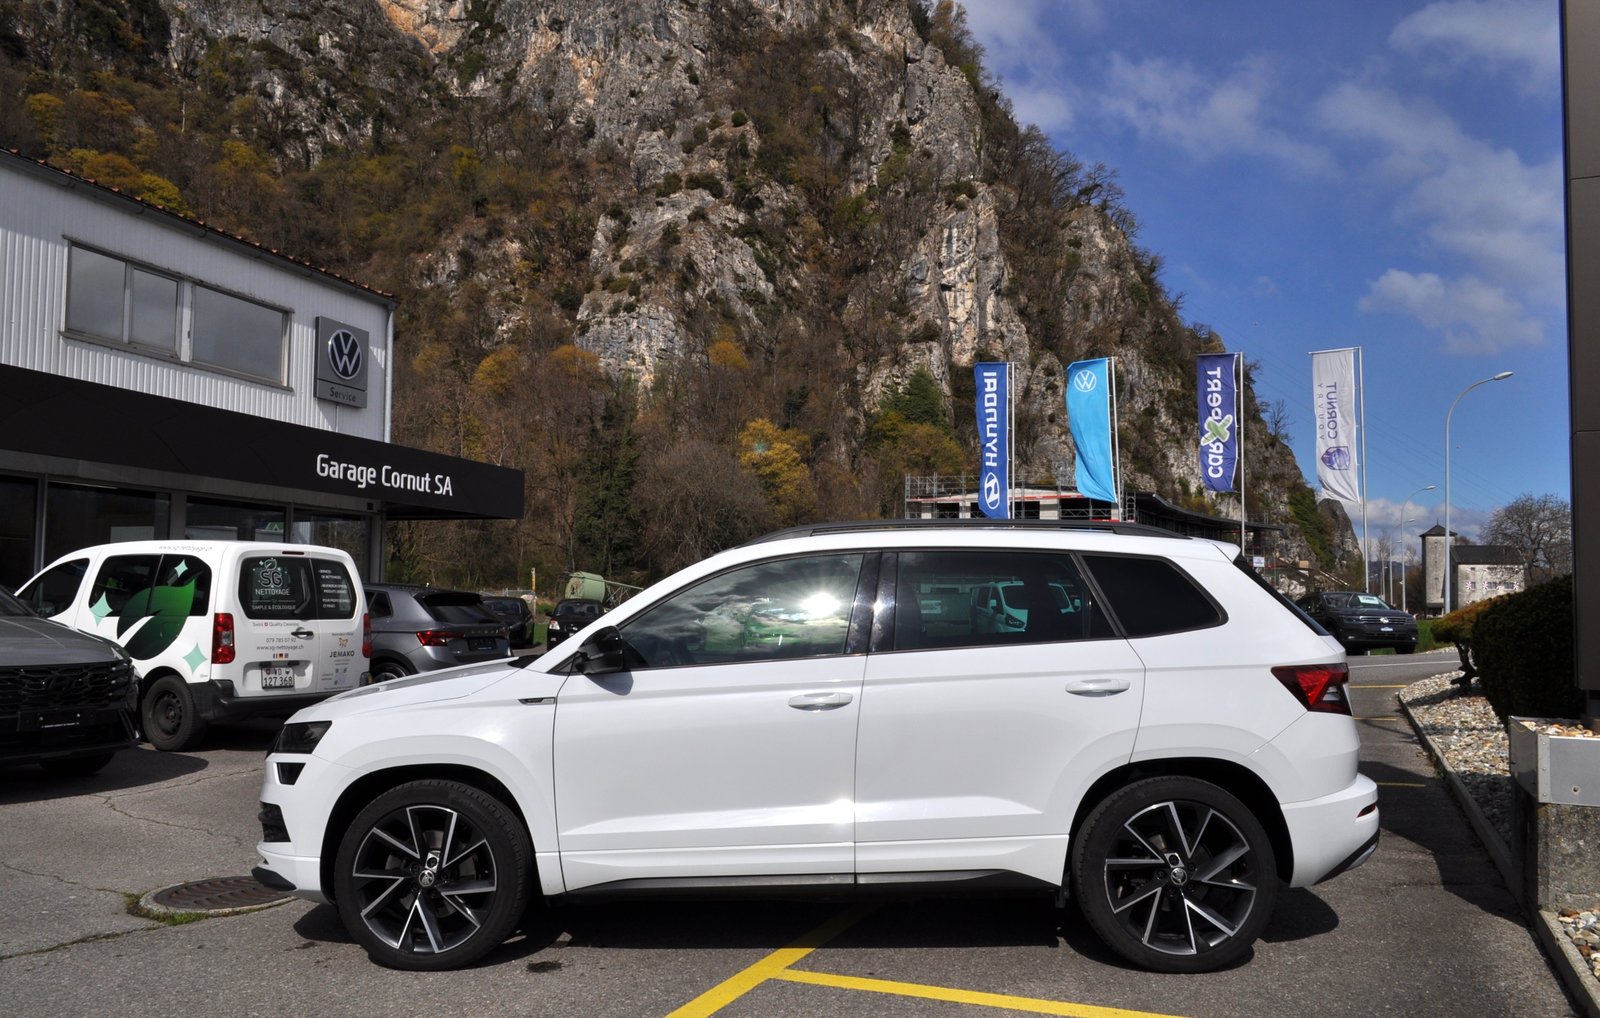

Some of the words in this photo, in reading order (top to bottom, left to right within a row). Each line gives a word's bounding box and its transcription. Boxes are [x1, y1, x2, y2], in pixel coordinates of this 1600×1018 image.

[329, 386, 356, 402] Service
[316, 454, 377, 488] Garage
[381, 465, 431, 493] Cornut
[434, 475, 453, 496] SA
[260, 570, 283, 588] SG
[255, 588, 291, 596] NETTOYAGE
[329, 650, 355, 658] JEMAKO
[264, 676, 278, 687] 127
[279, 676, 293, 686] 368
